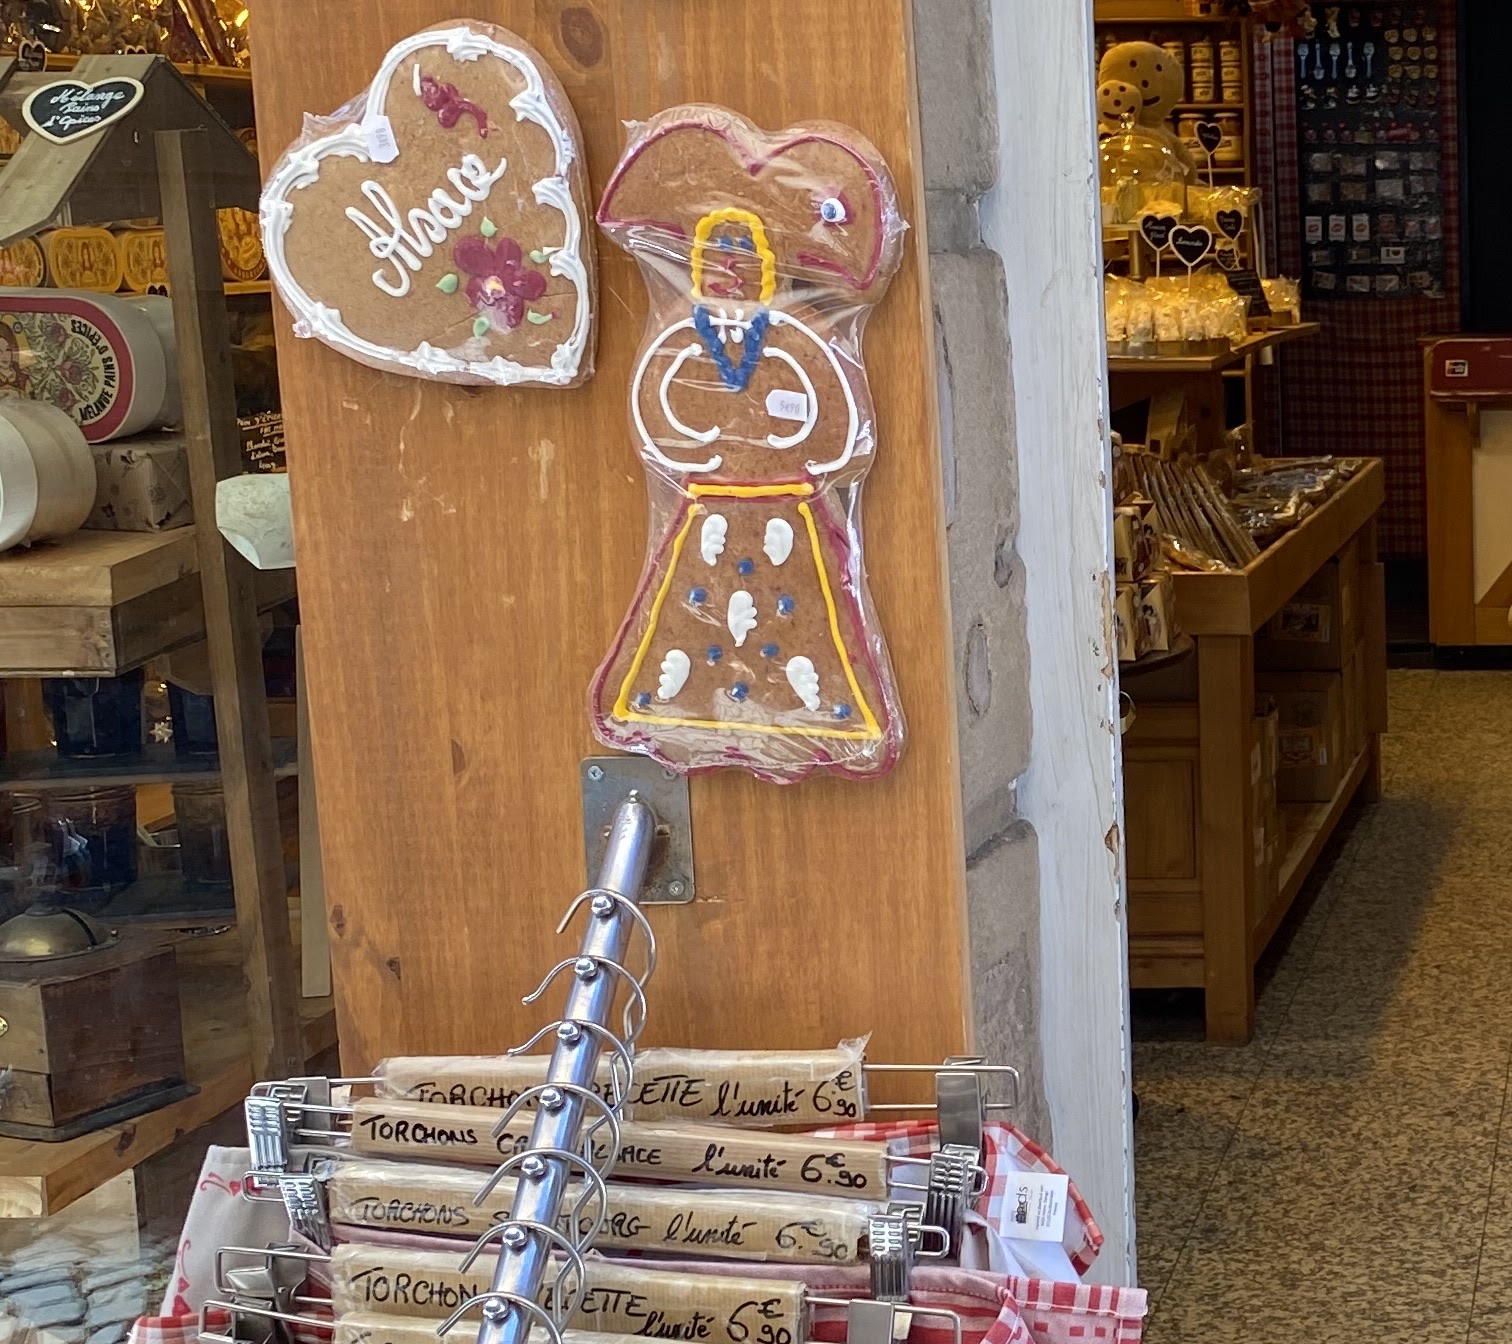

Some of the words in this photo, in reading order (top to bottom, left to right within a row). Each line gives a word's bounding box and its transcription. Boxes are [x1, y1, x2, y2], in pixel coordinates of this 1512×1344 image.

[345, 154, 508, 298] Alsace
[406, 1081, 543, 1108] TORCHO
[709, 1079, 806, 1117] l'unité
[360, 1114, 479, 1146] TORCHONS
[691, 1143, 787, 1179] l'unité
[350, 1196, 470, 1226] TORCHONS
[662, 1210, 757, 1246] l'unité
[350, 1266, 491, 1309] TORCHON
[632, 1309, 716, 1340] l'unité
